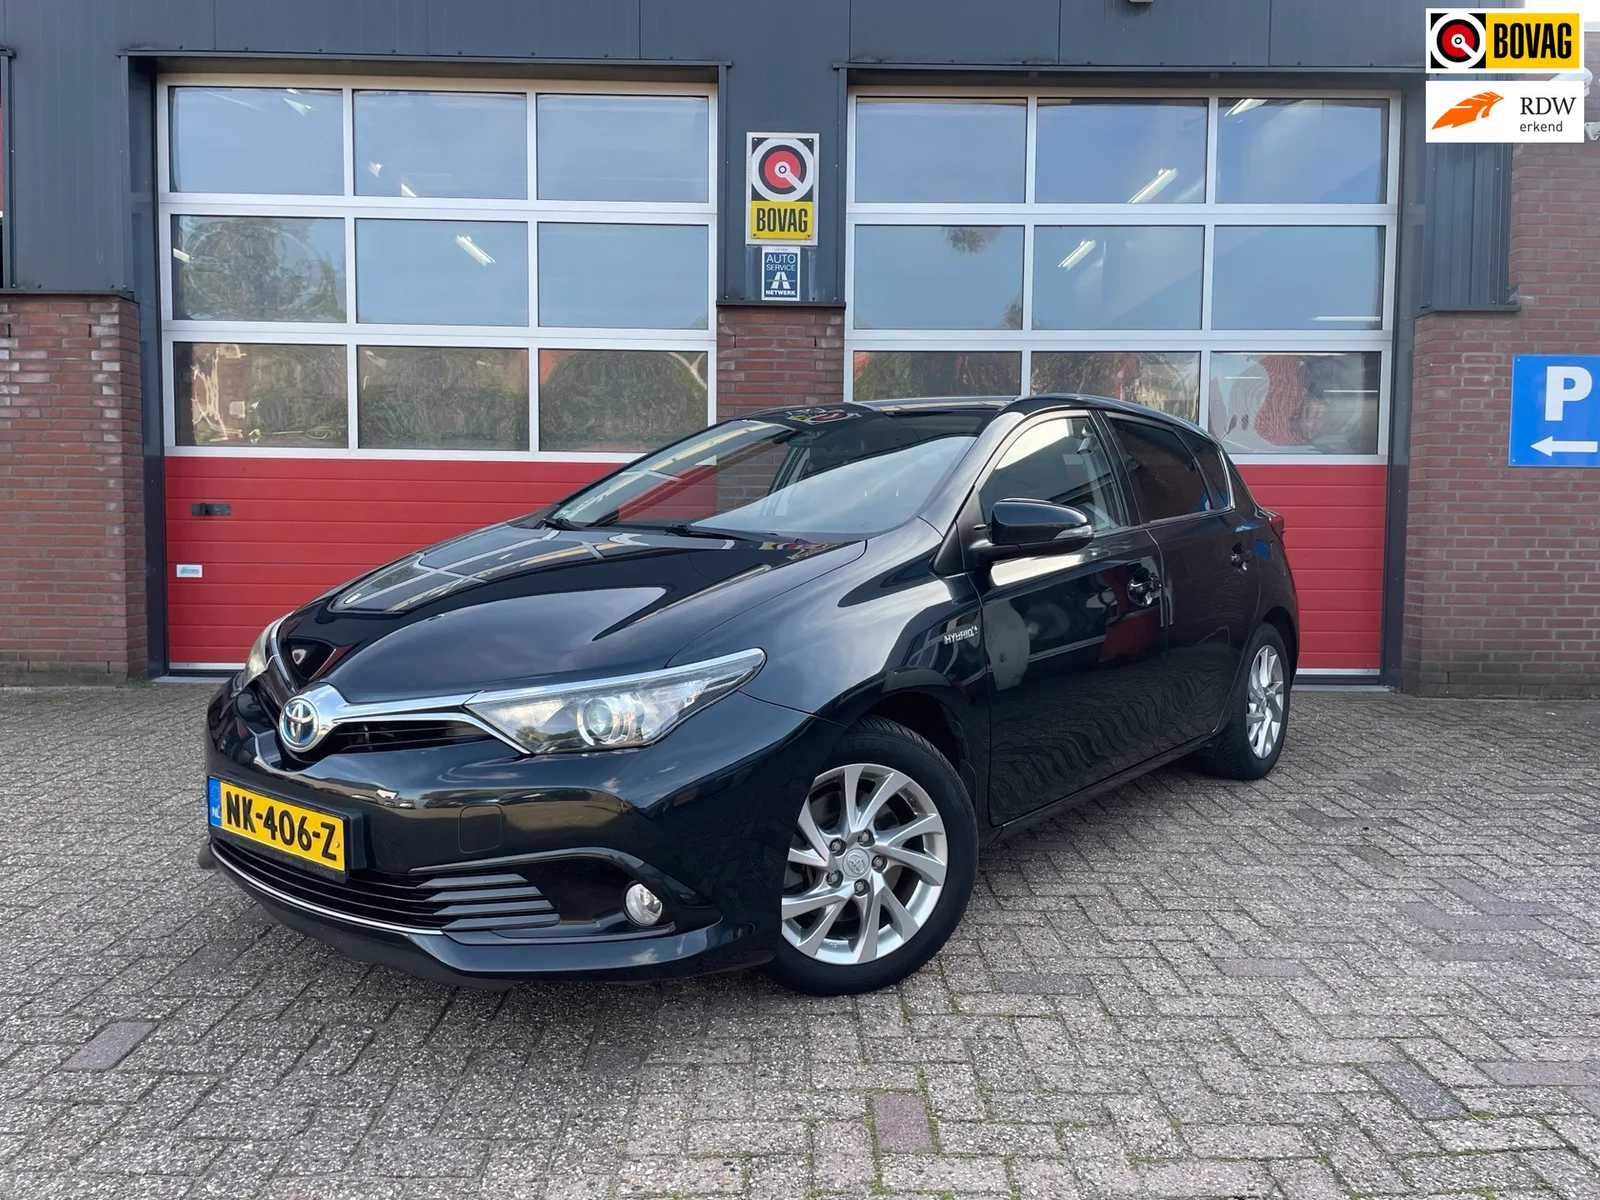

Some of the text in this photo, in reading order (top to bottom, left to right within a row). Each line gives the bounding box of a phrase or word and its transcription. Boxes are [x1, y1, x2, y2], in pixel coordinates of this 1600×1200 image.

[756, 207, 808, 233] BOVAG
[766, 253, 796, 264] AUTO
[766, 263, 796, 272] SERVICE
[1545, 366, 1592, 421] P
[943, 627, 975, 645] HYBRID
[225, 791, 337, 862] NK-406-Z
